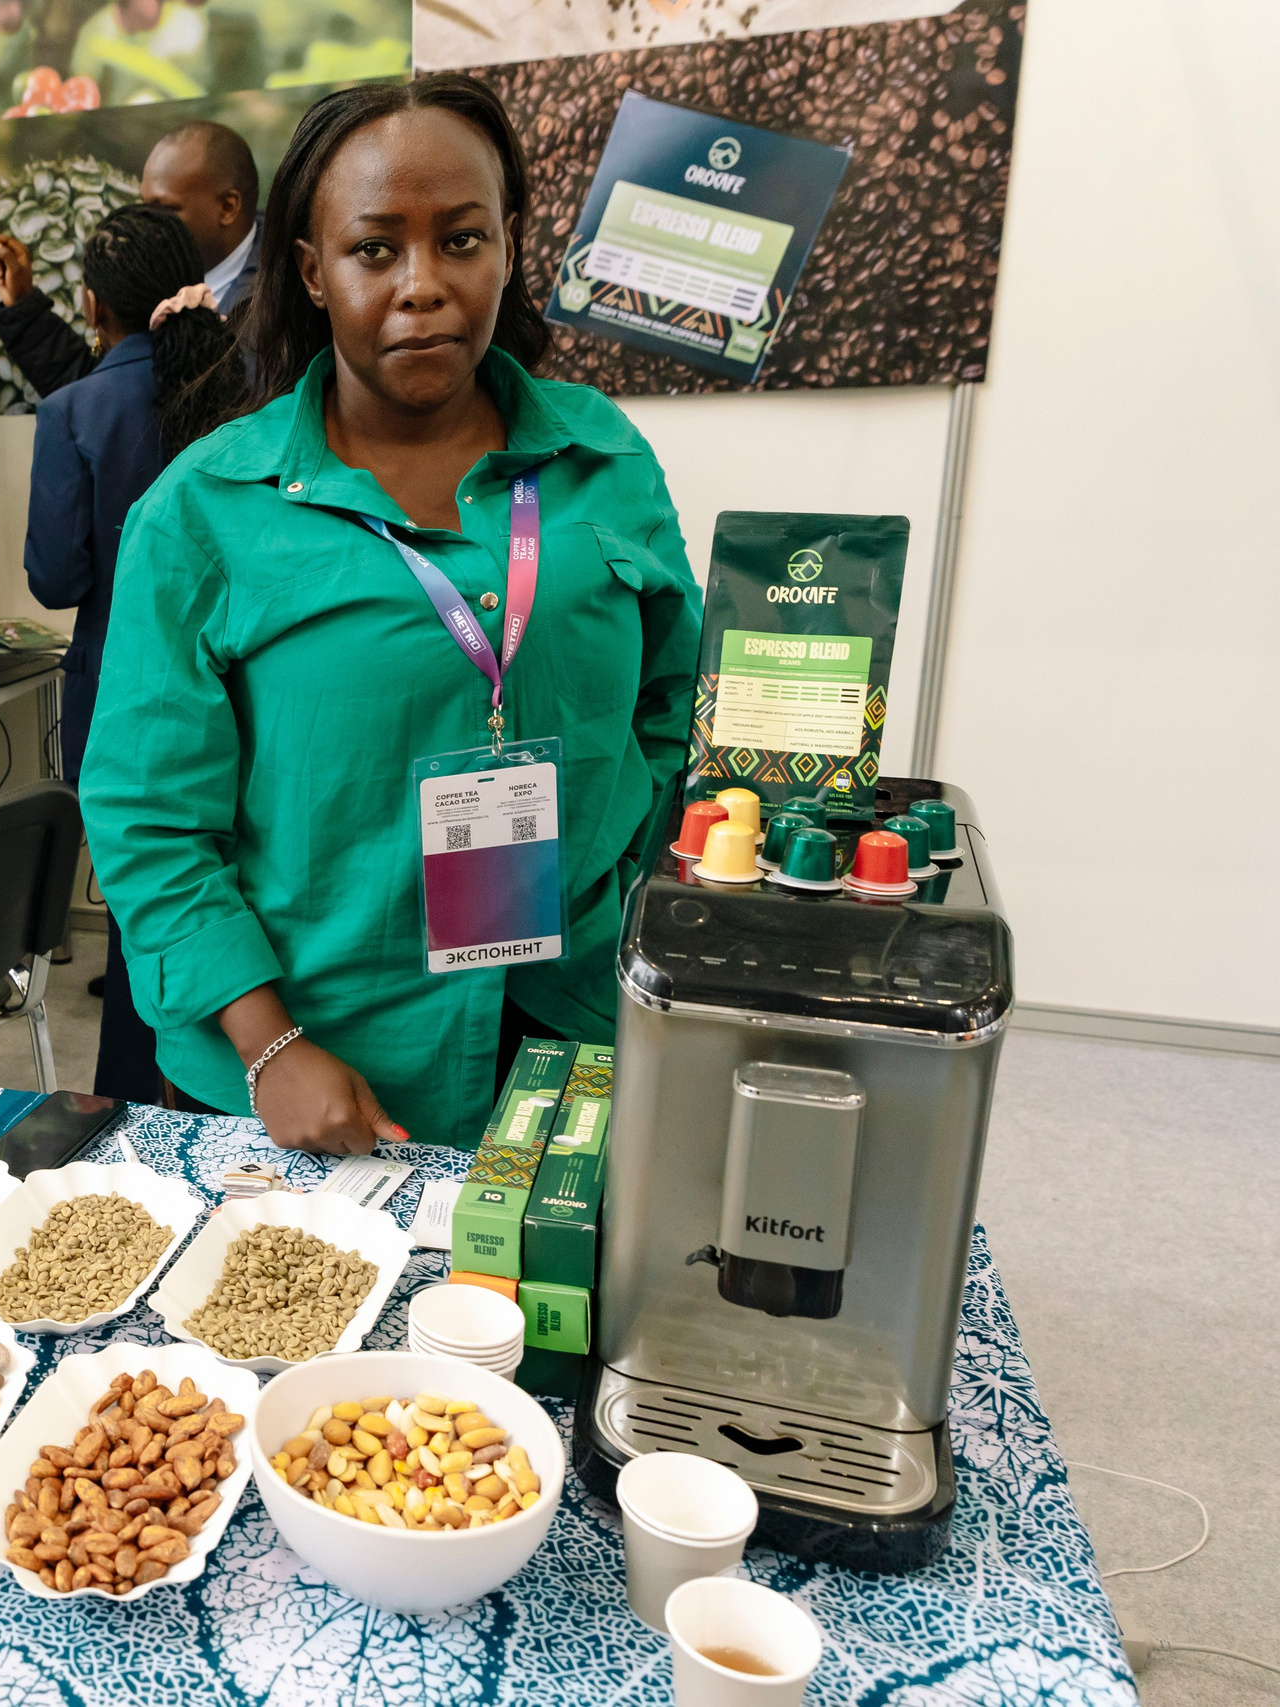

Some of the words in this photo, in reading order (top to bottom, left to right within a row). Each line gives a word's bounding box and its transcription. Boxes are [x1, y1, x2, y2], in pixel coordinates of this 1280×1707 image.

[630, 199, 712, 243] ESPRESSO
[707, 220, 763, 256] BLEND
[514, 479, 524, 504] HORECA
[525, 486, 535, 504] EXPO
[513, 537, 521, 560] COFFEE
[527, 537, 536, 560] CACAO
[766, 585, 838, 605] OROCAFE
[451, 609, 481, 651] METRO
[504, 617, 521, 662] METRO
[744, 637, 807, 659] ESPRESSO
[809, 641, 851, 661] BLEND
[778, 658, 802, 667] BEANS
[436, 792, 464, 801] COFFEE
[508, 783, 538, 791] HORECA
[514, 790, 533, 798] EXPO
[435, 800, 460, 808] CACAO
[461, 797, 481, 805] EXPO
[445, 941, 543, 965] ЭКСПОНЕНТ
[527, 1047, 566, 1057] OROCAFE
[541, 1197, 588, 1209] OROCAFE
[466, 1232, 505, 1247] ESPRESSO
[745, 1215, 825, 1243] Kitfort
[473, 1244, 498, 1257] BLEND
[537, 1302, 548, 1336] ESPRESSO
[550, 1310, 561, 1332] BLEND
